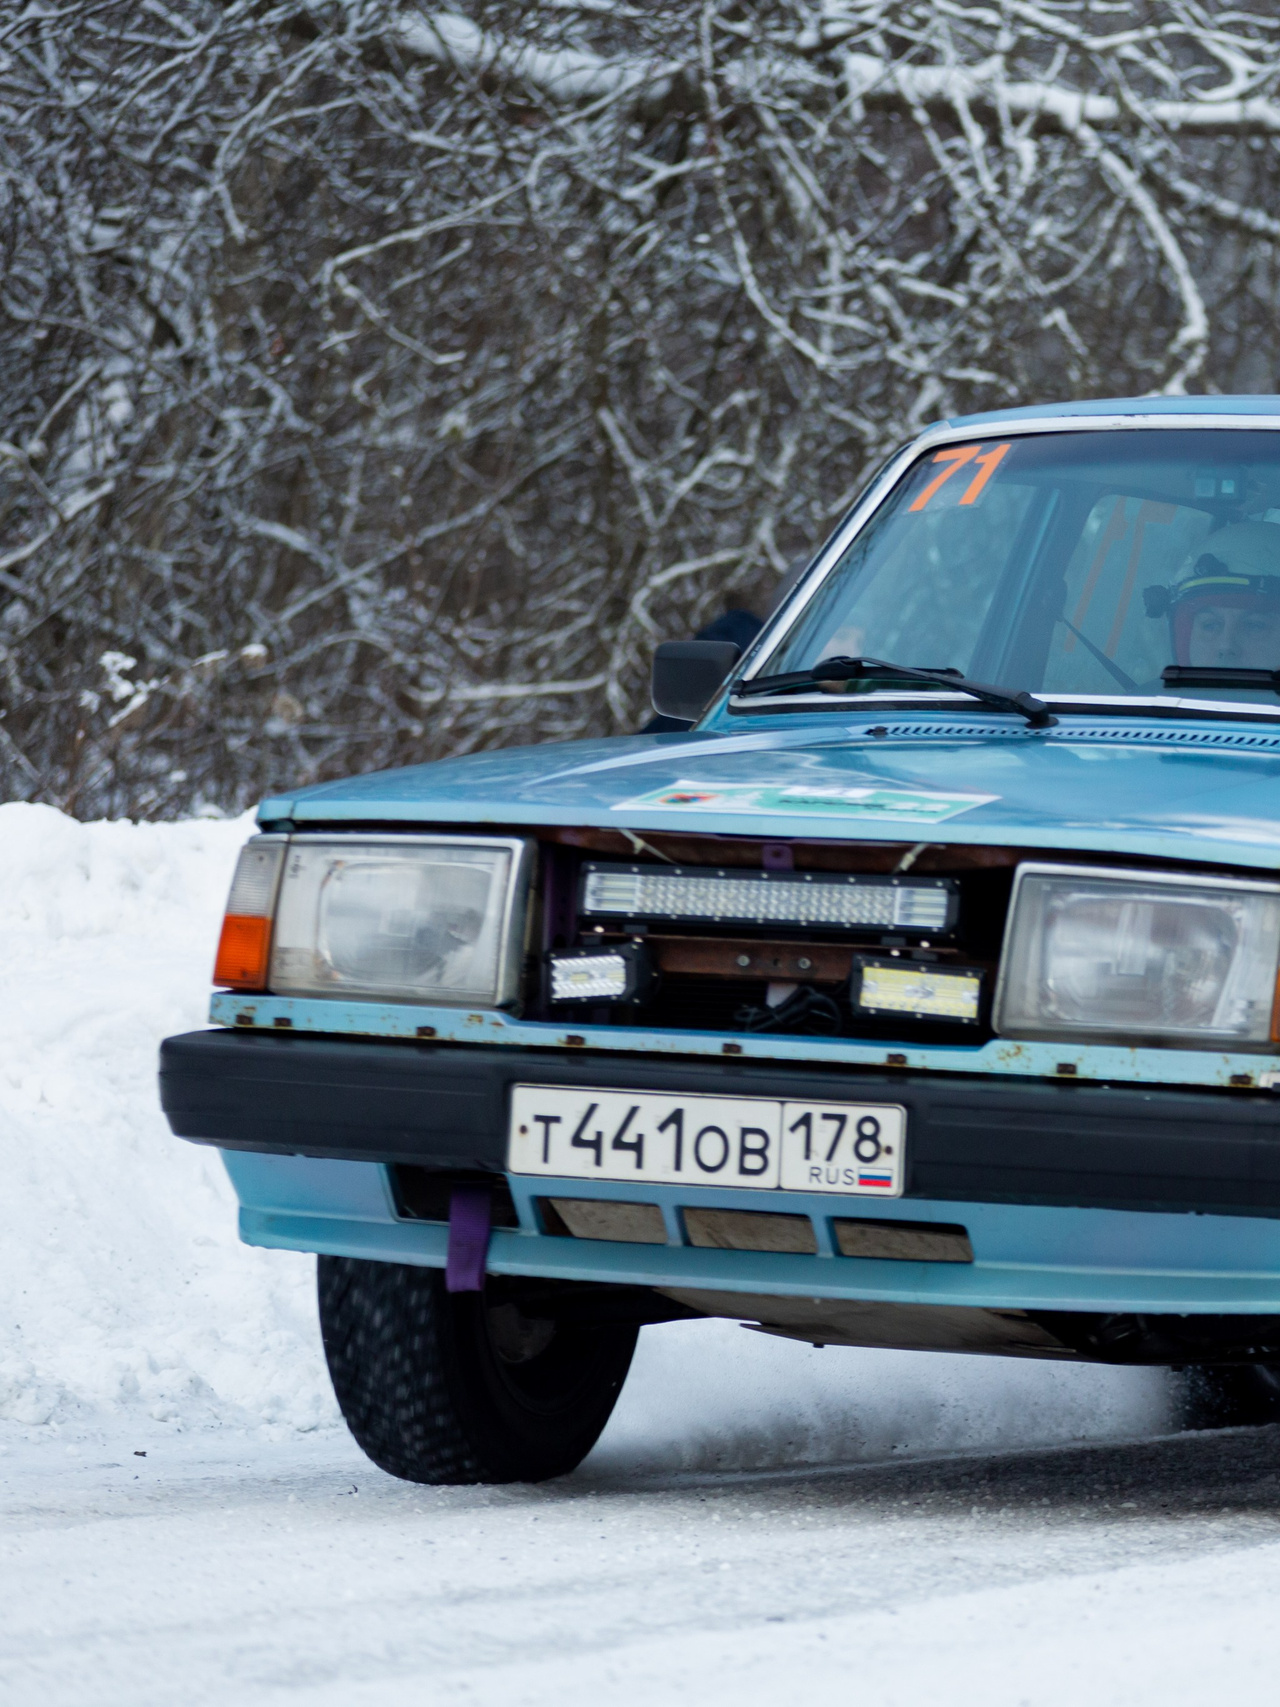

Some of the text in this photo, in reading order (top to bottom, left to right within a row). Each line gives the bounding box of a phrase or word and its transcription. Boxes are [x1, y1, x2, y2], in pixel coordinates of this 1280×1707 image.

[908, 443, 1012, 512] 71
[789, 1112, 881, 1163] 178
[809, 1167, 855, 1186] RUS
